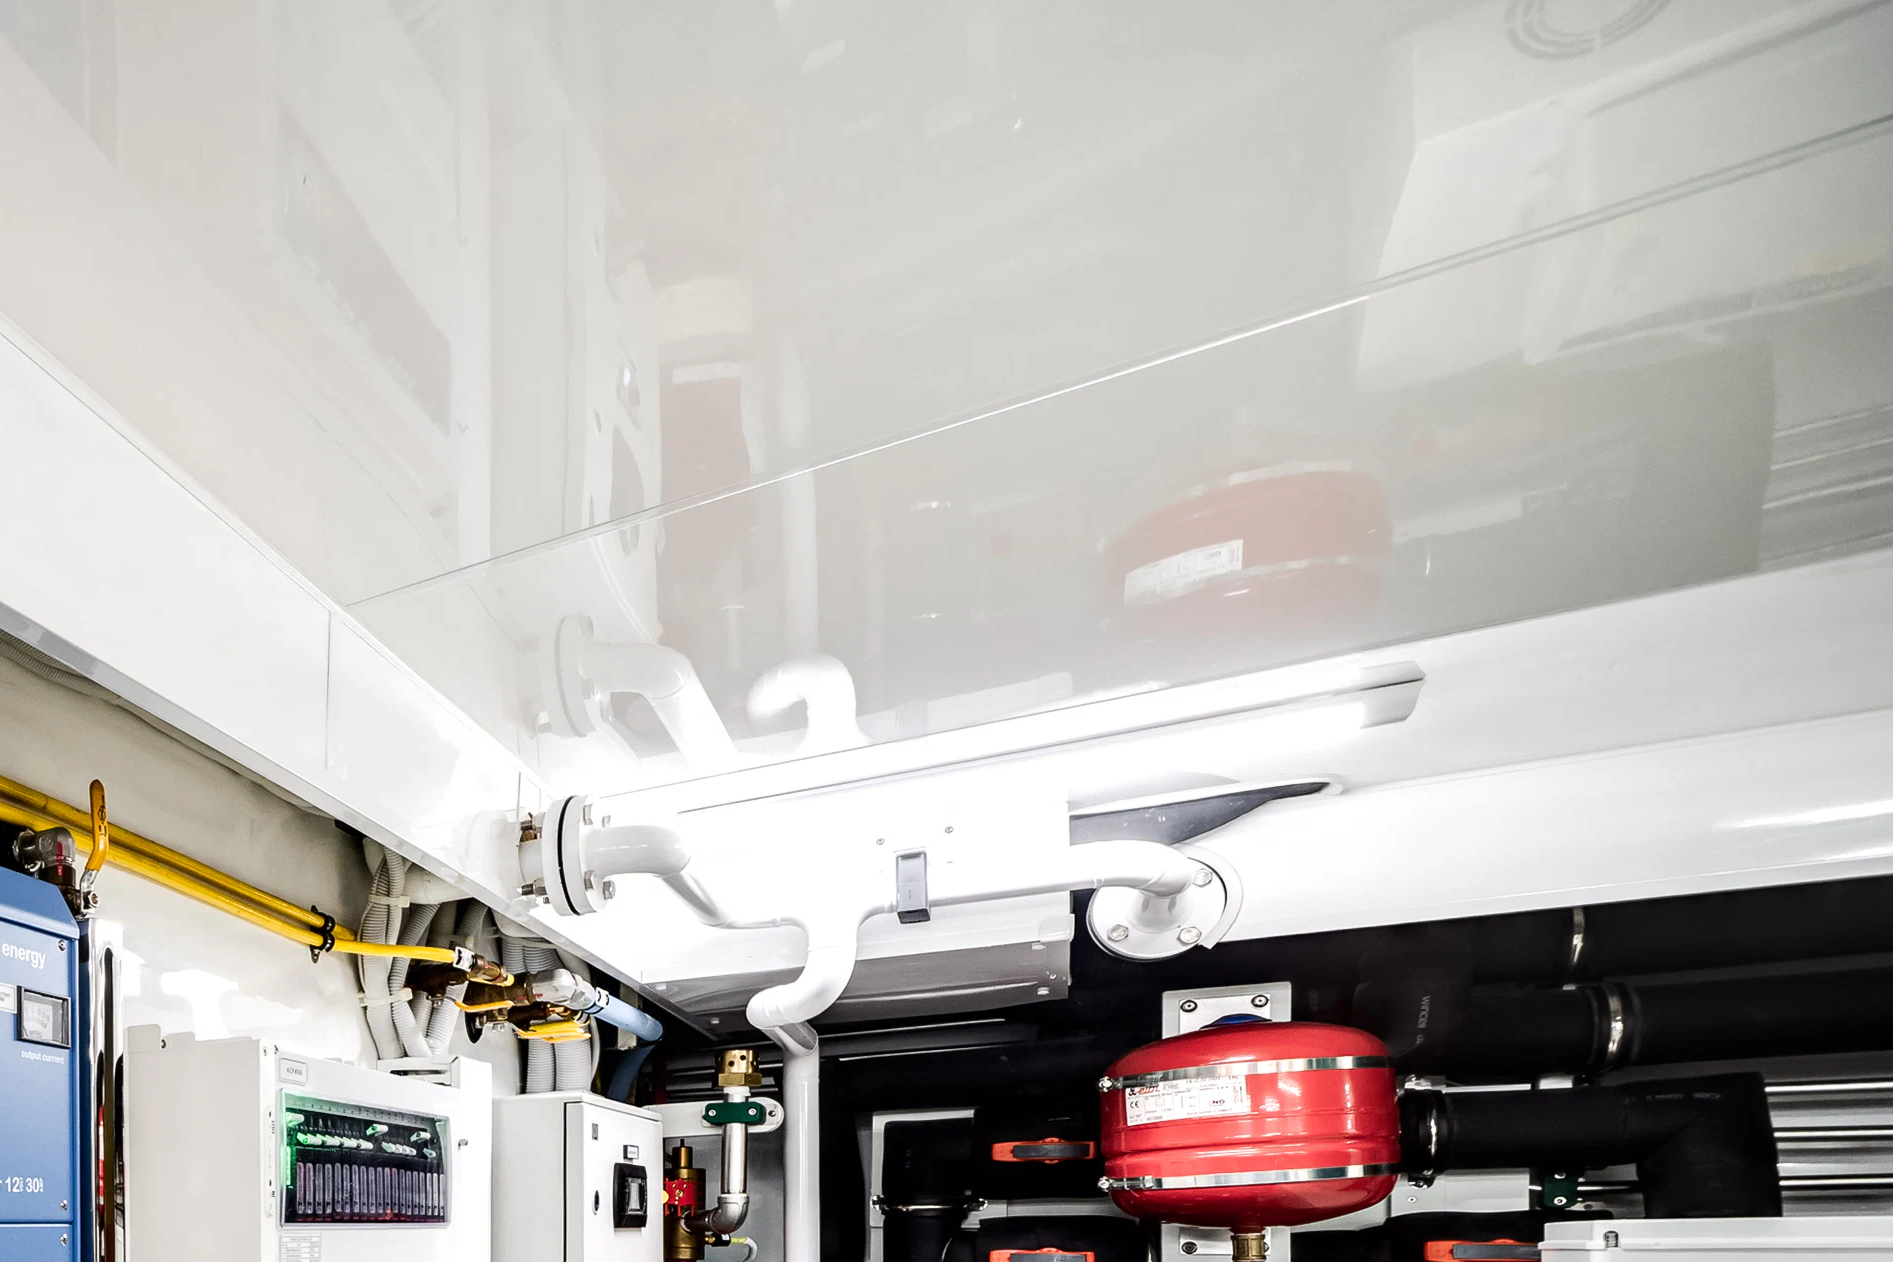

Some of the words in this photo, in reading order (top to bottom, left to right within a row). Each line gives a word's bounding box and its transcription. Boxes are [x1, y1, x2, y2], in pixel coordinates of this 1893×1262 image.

[1, 943, 47, 970] energy
[21, 1050, 41, 1062] output
[41, 1053, 65, 1065] current
[5, 1176, 20, 1193] 12
[25, 1177, 39, 1193] 30
